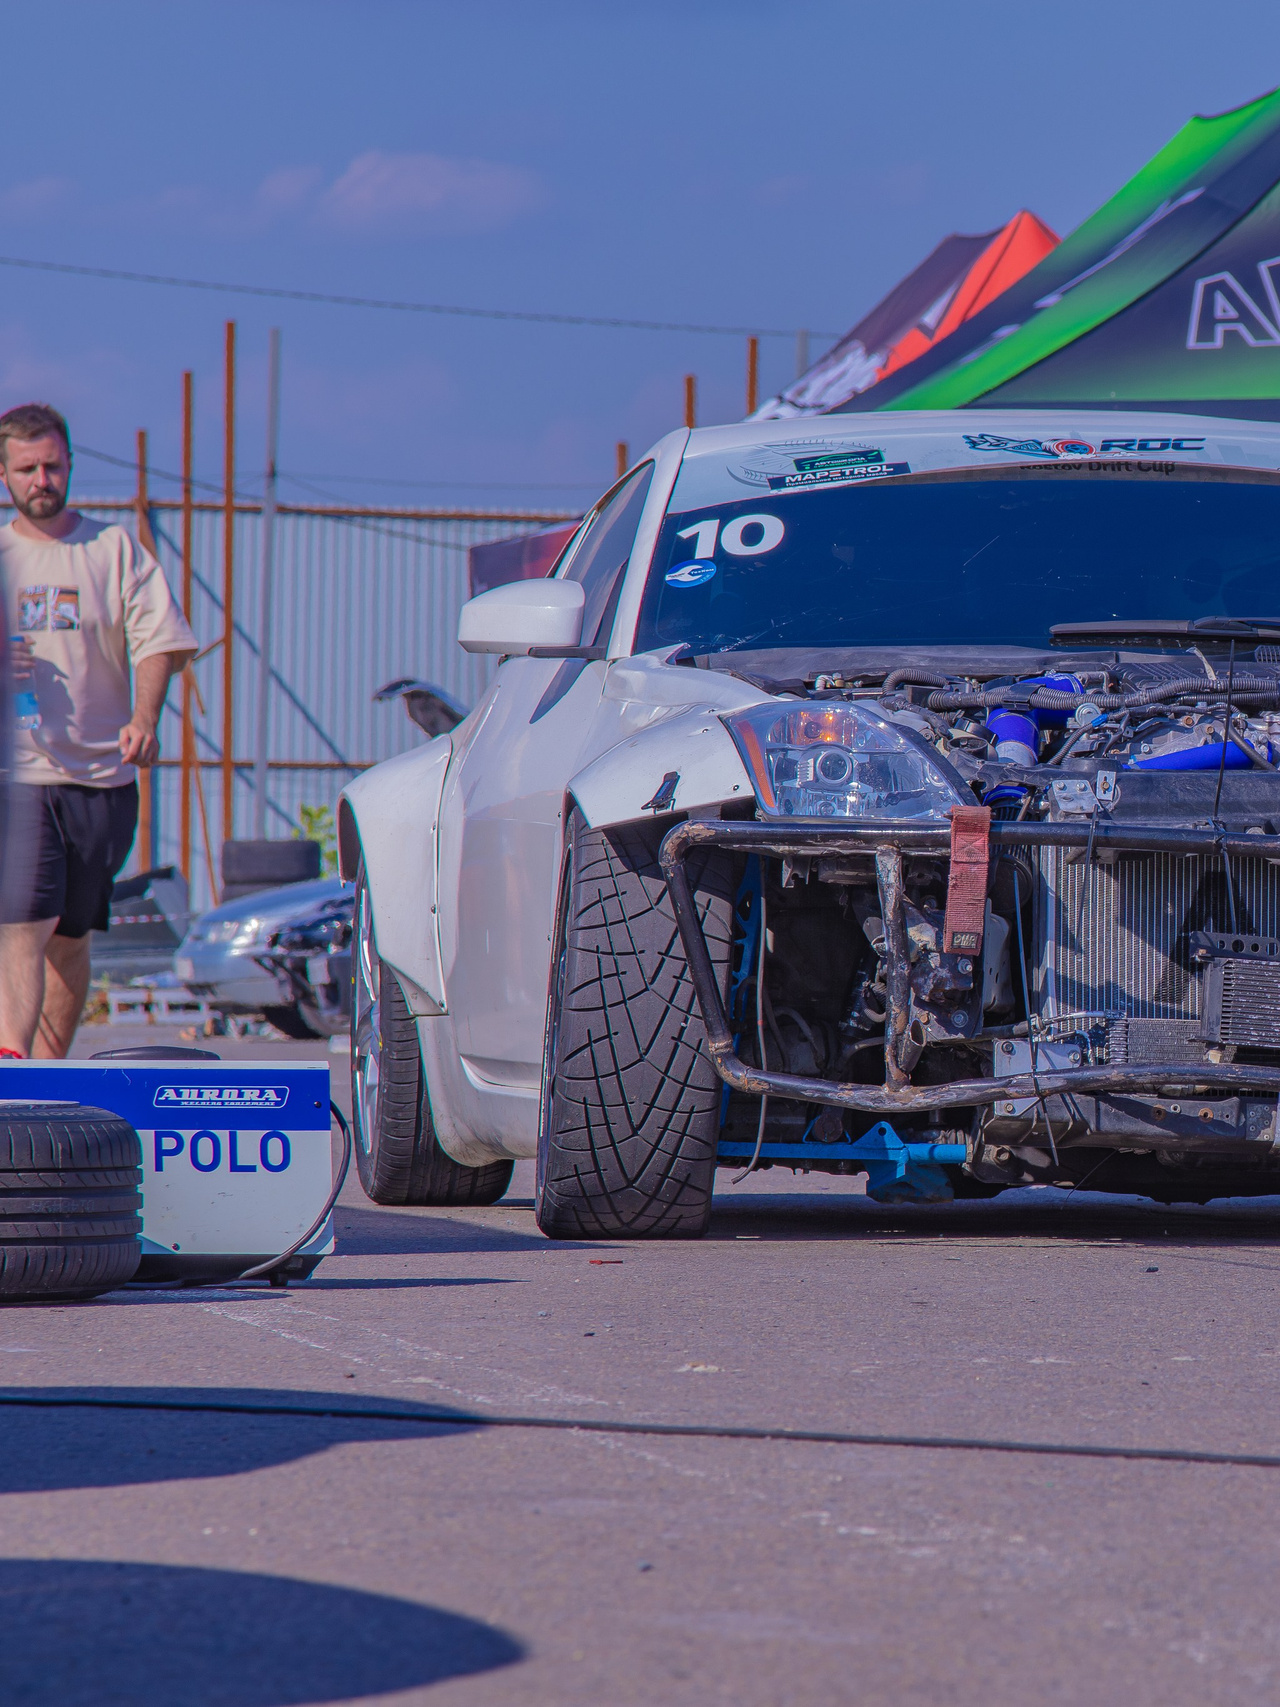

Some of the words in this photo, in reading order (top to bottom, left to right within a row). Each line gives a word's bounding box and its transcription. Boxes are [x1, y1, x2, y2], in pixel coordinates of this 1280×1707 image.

[1100, 437, 1207, 452] RDC
[785, 464, 894, 483] MAPETROL
[1088, 461, 1132, 472] Drift
[1137, 461, 1176, 475] Cup
[677, 514, 785, 559] 10
[158, 1088, 281, 1101] AURORA
[155, 1130, 291, 1173] POLO
